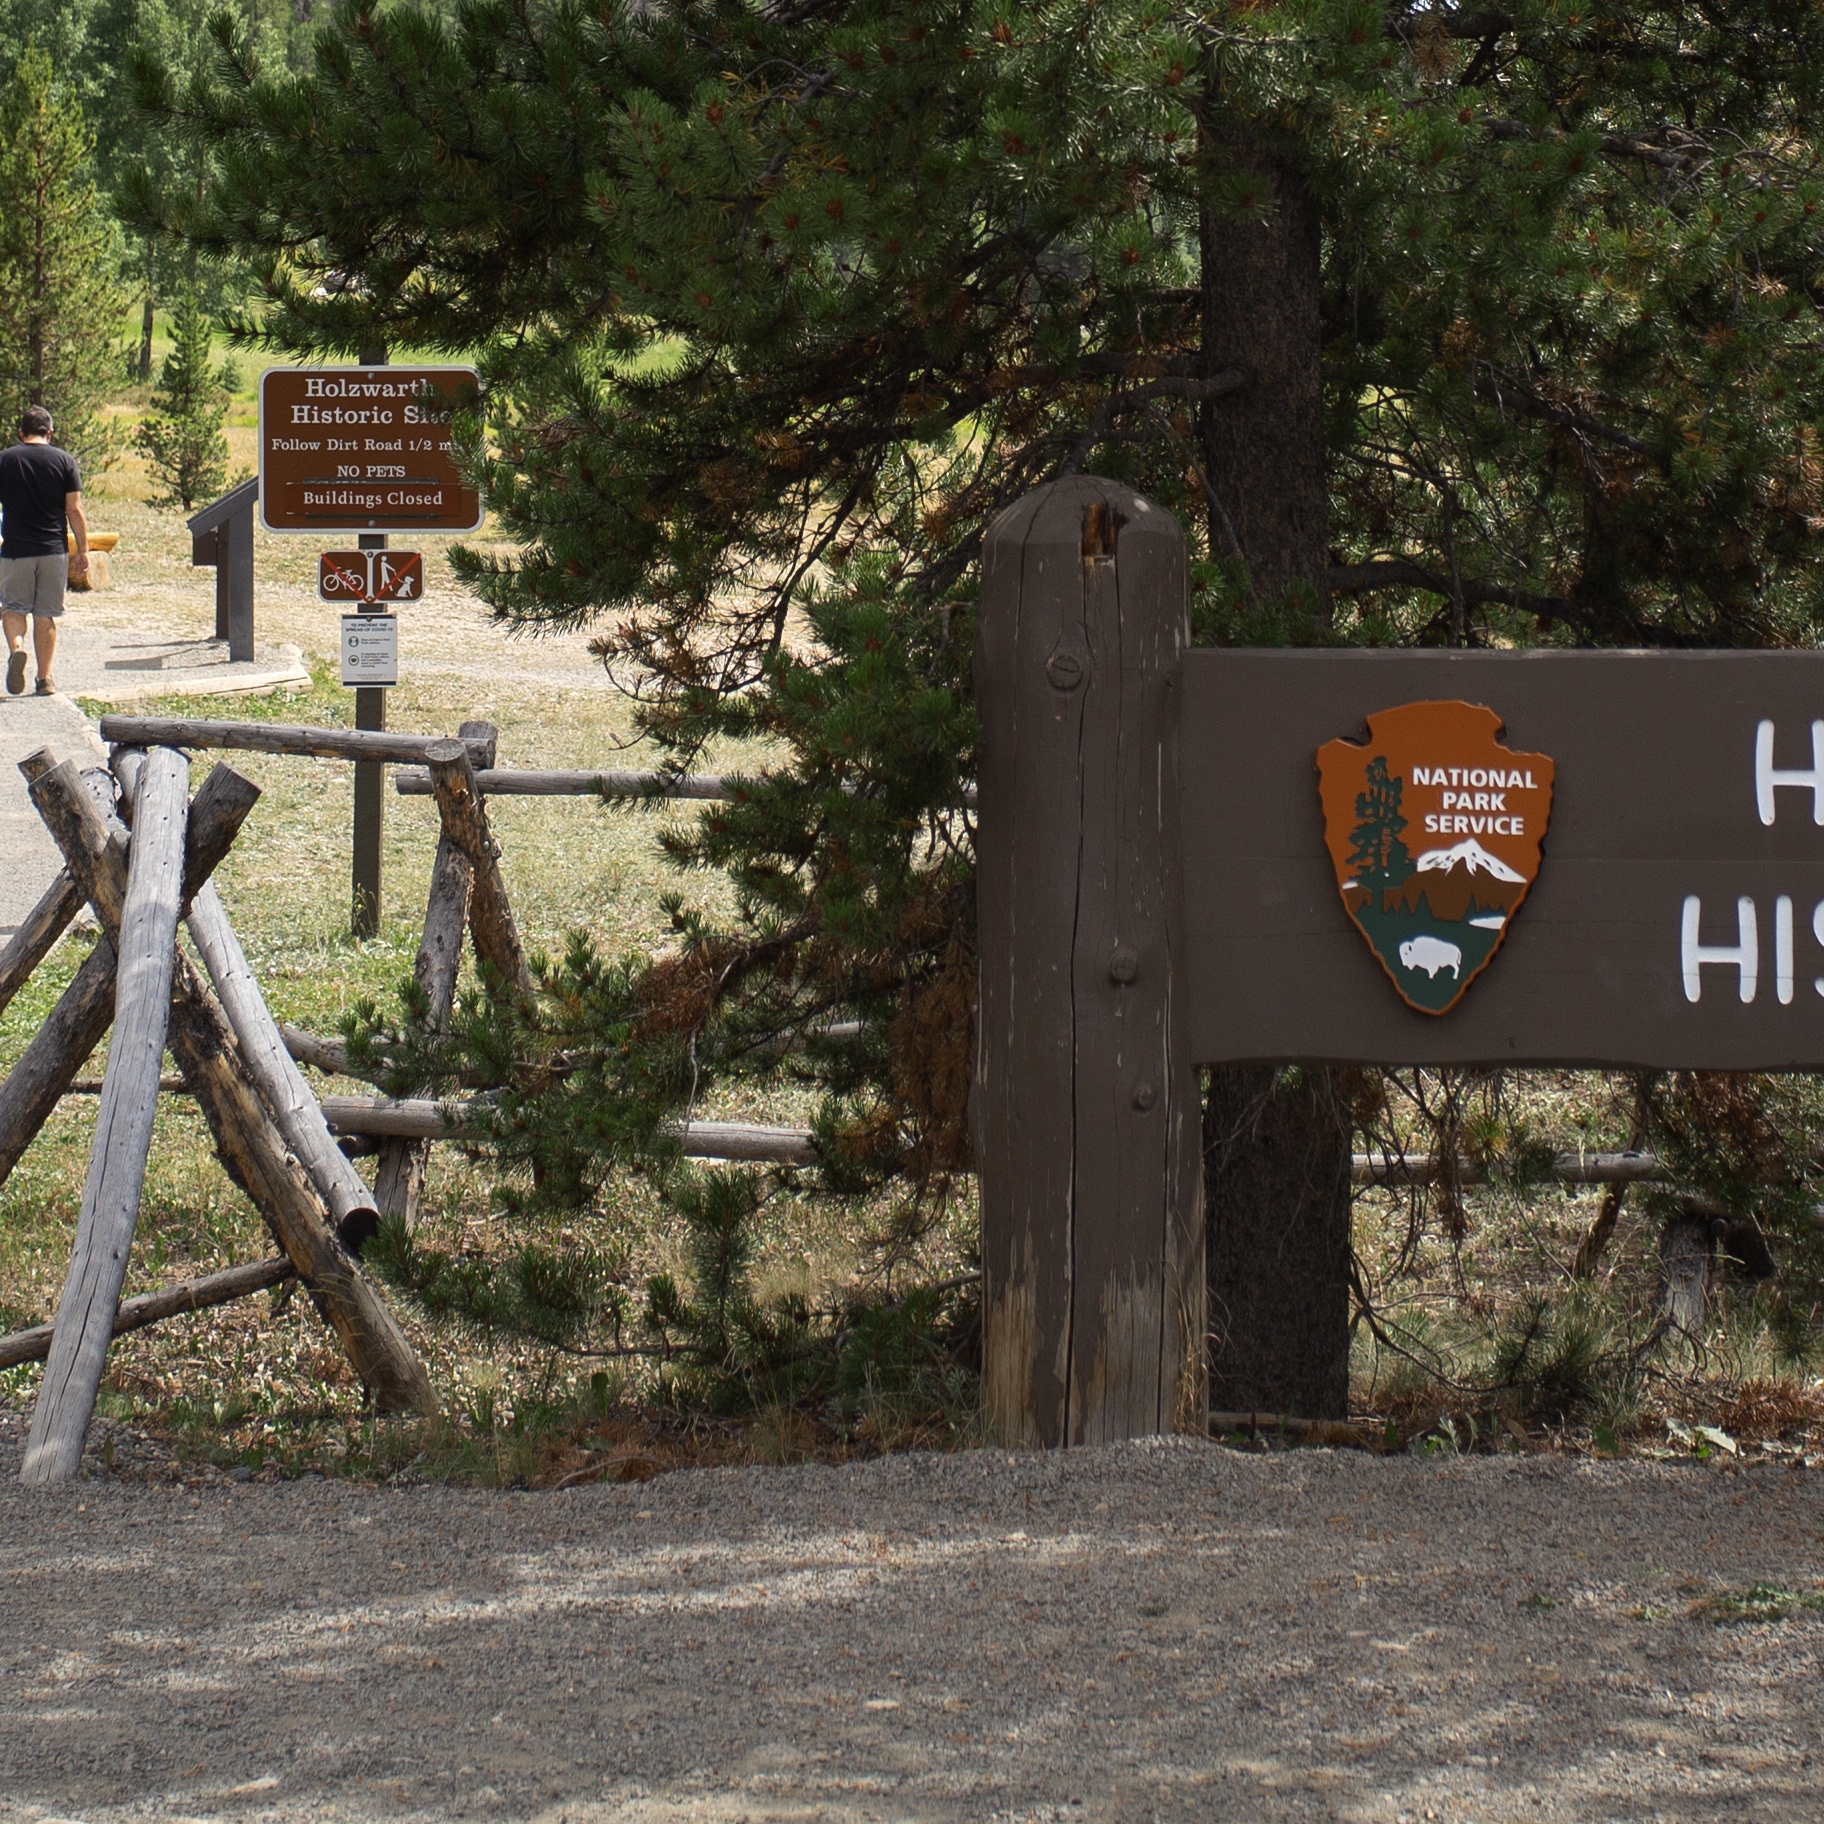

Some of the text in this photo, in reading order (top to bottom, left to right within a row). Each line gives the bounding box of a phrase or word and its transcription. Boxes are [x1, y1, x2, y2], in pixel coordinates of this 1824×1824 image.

[305, 378, 435, 397] Holzwarth
[290, 405, 393, 424] Historic
[271, 438, 321, 451] Follow
[327, 438, 358, 451] Dirt
[364, 438, 403, 451] Road
[409, 437, 433, 452] 1/2
[337, 465, 406, 477] NO PETS
[303, 490, 443, 509] Buildings Closed
[1412, 767, 1538, 789] NATIONAL
[1442, 791, 1506, 811] PARK
[1424, 814, 1524, 836] SERVICE
